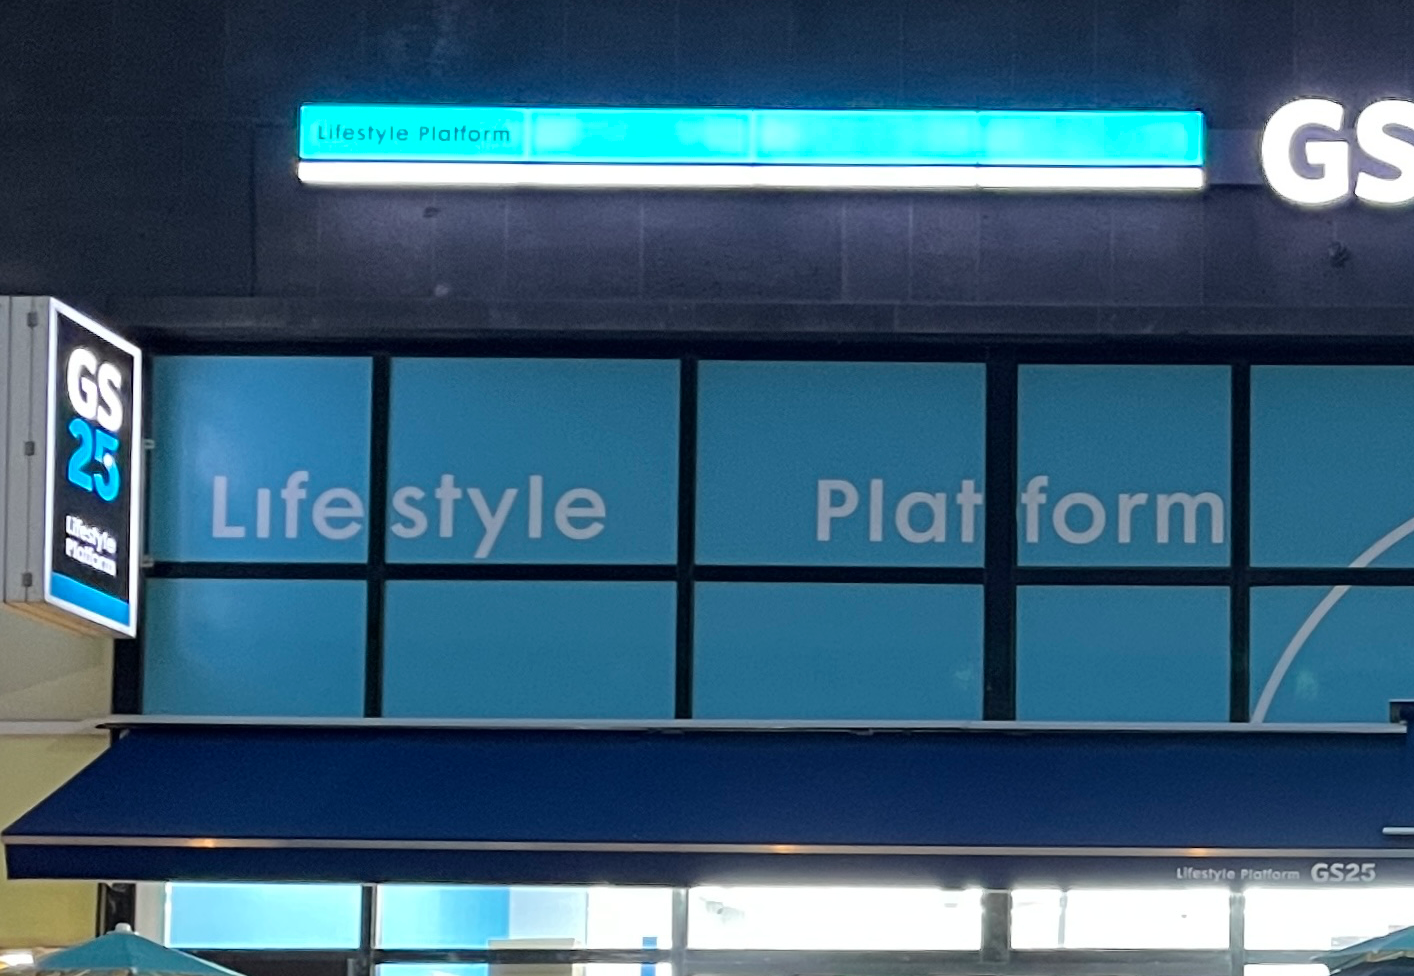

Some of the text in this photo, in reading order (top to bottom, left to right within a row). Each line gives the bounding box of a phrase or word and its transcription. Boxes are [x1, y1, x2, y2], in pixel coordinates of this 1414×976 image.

[318, 125, 510, 145] Lifestyle Platform
[66, 347, 123, 432] GS
[67, 418, 119, 501] 25
[65, 514, 117, 555] Lifestyle
[65, 536, 117, 577] Platform
[1176, 863, 1376, 883] Lifestyle Platform GS25
